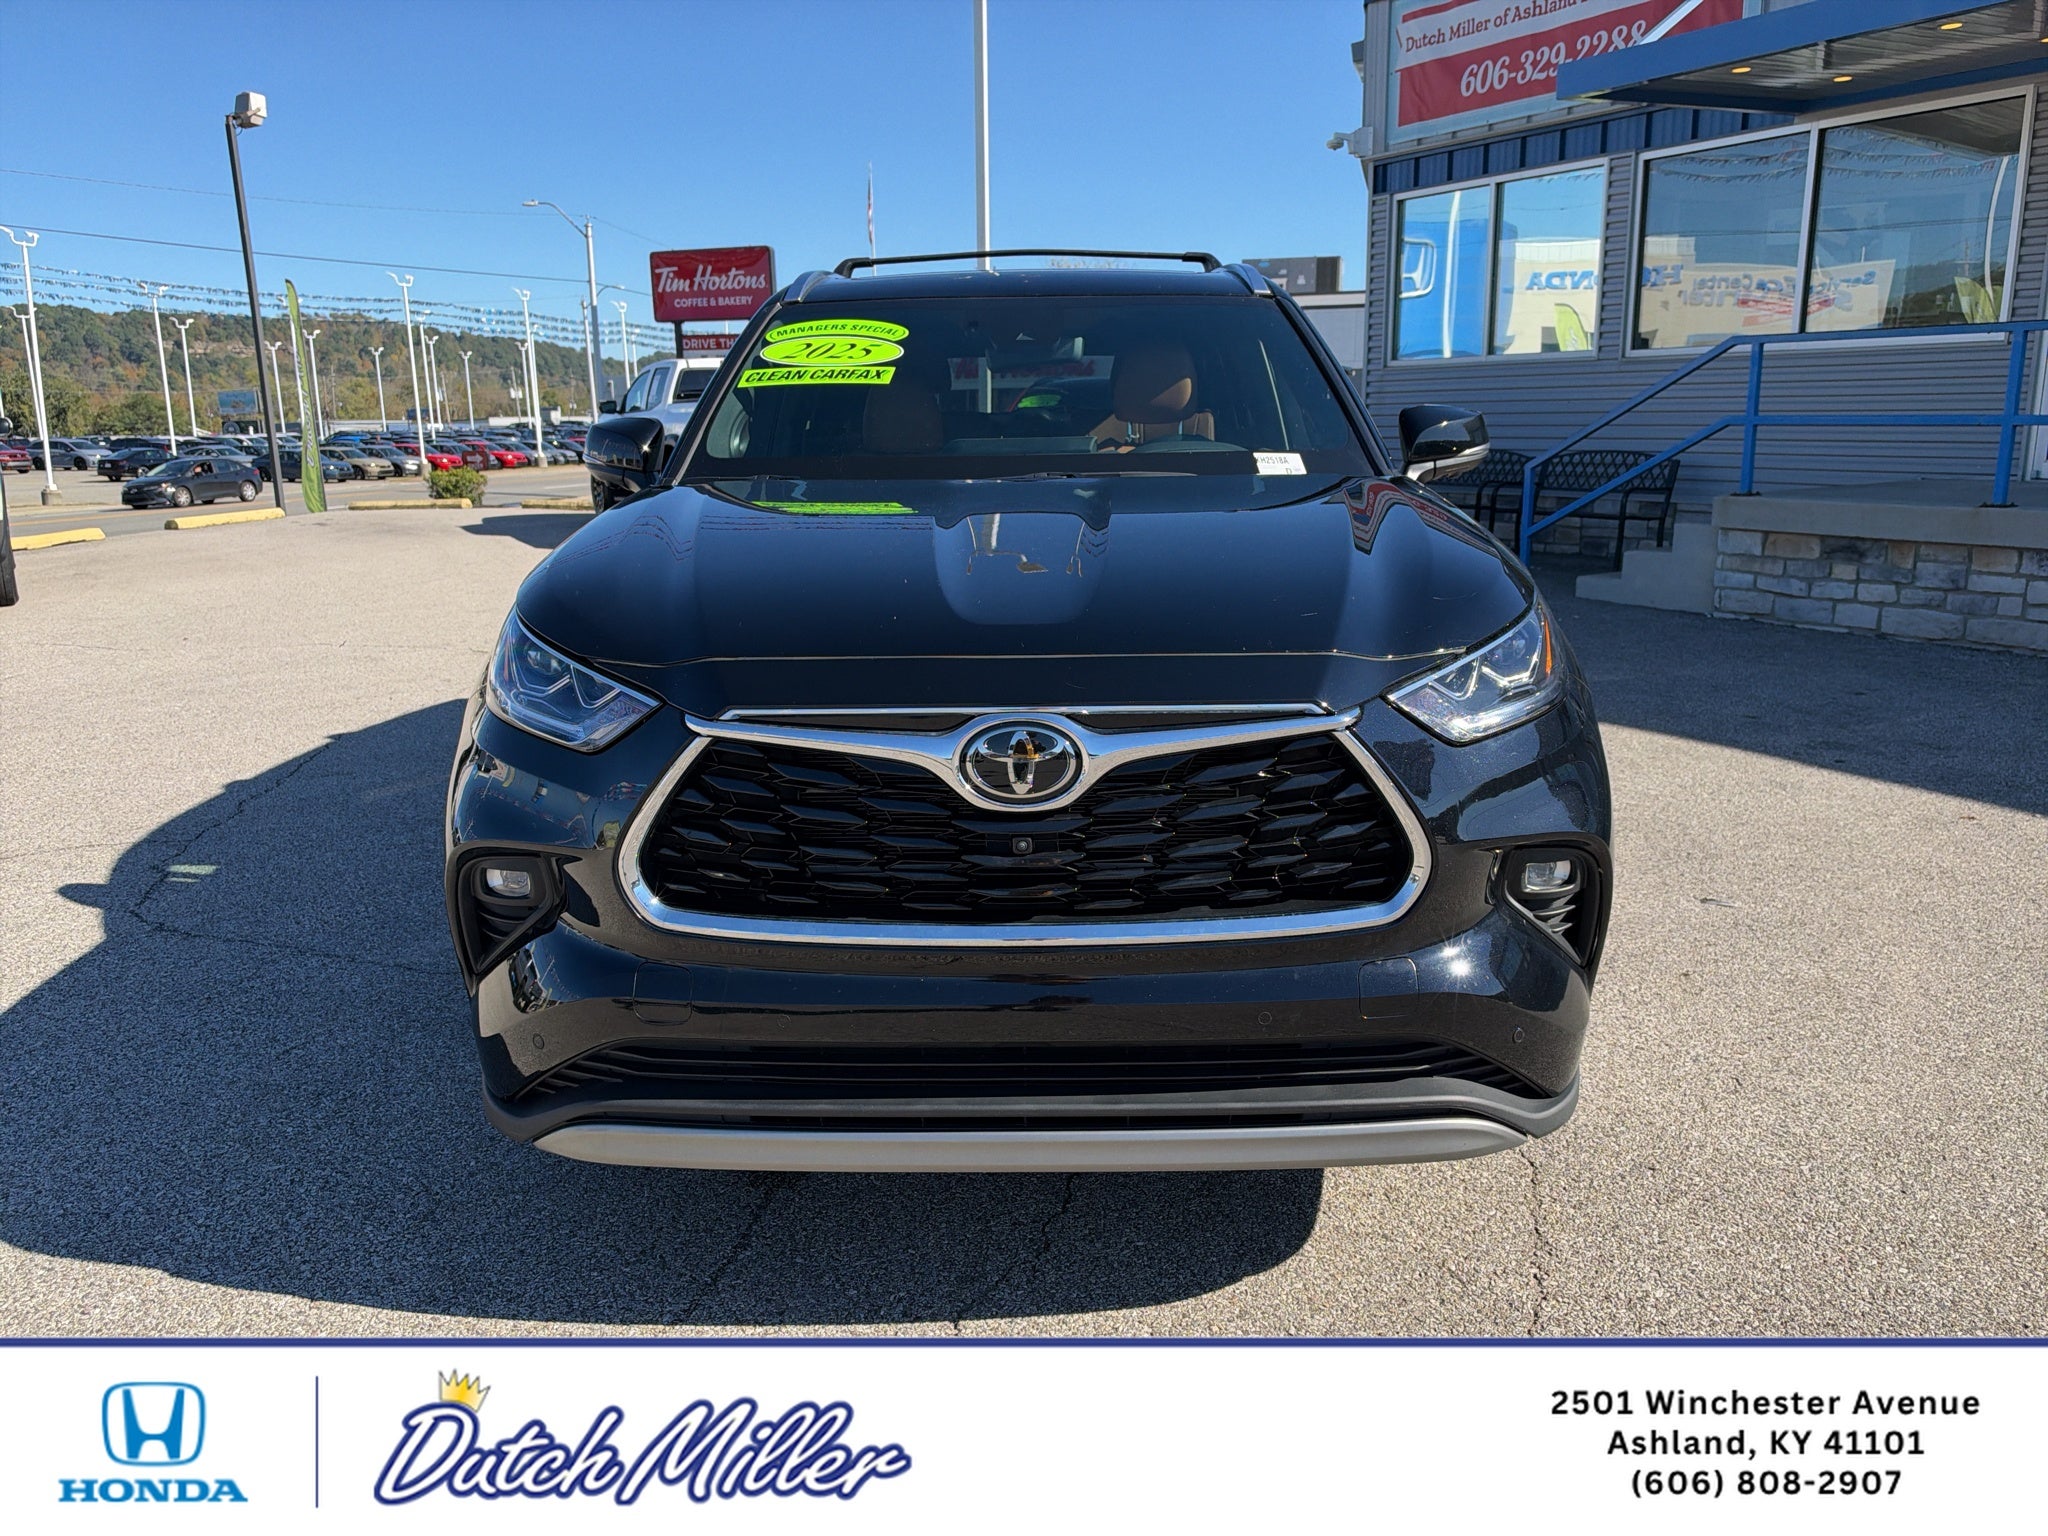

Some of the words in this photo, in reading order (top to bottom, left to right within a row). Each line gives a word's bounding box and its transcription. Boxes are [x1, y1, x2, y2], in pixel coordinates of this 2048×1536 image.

[1405, 28, 1446, 52] Dutch
[1449, 17, 1491, 41] Miller
[1494, 9, 1511, 26] of
[655, 267, 690, 293] Tim
[693, 264, 767, 292] Hortons
[674, 297, 708, 308] COFFEE
[710, 297, 717, 307] &
[718, 295, 754, 306] BAKERY
[776, 323, 848, 336] MANAGERS
[851, 323, 899, 337] SPECIAL
[682, 338, 717, 349] DRIVE
[719, 337, 737, 348] TH
[780, 343, 884, 360] 2025
[745, 368, 805, 383] CLEAN
[808, 368, 886, 382] CARFAX
